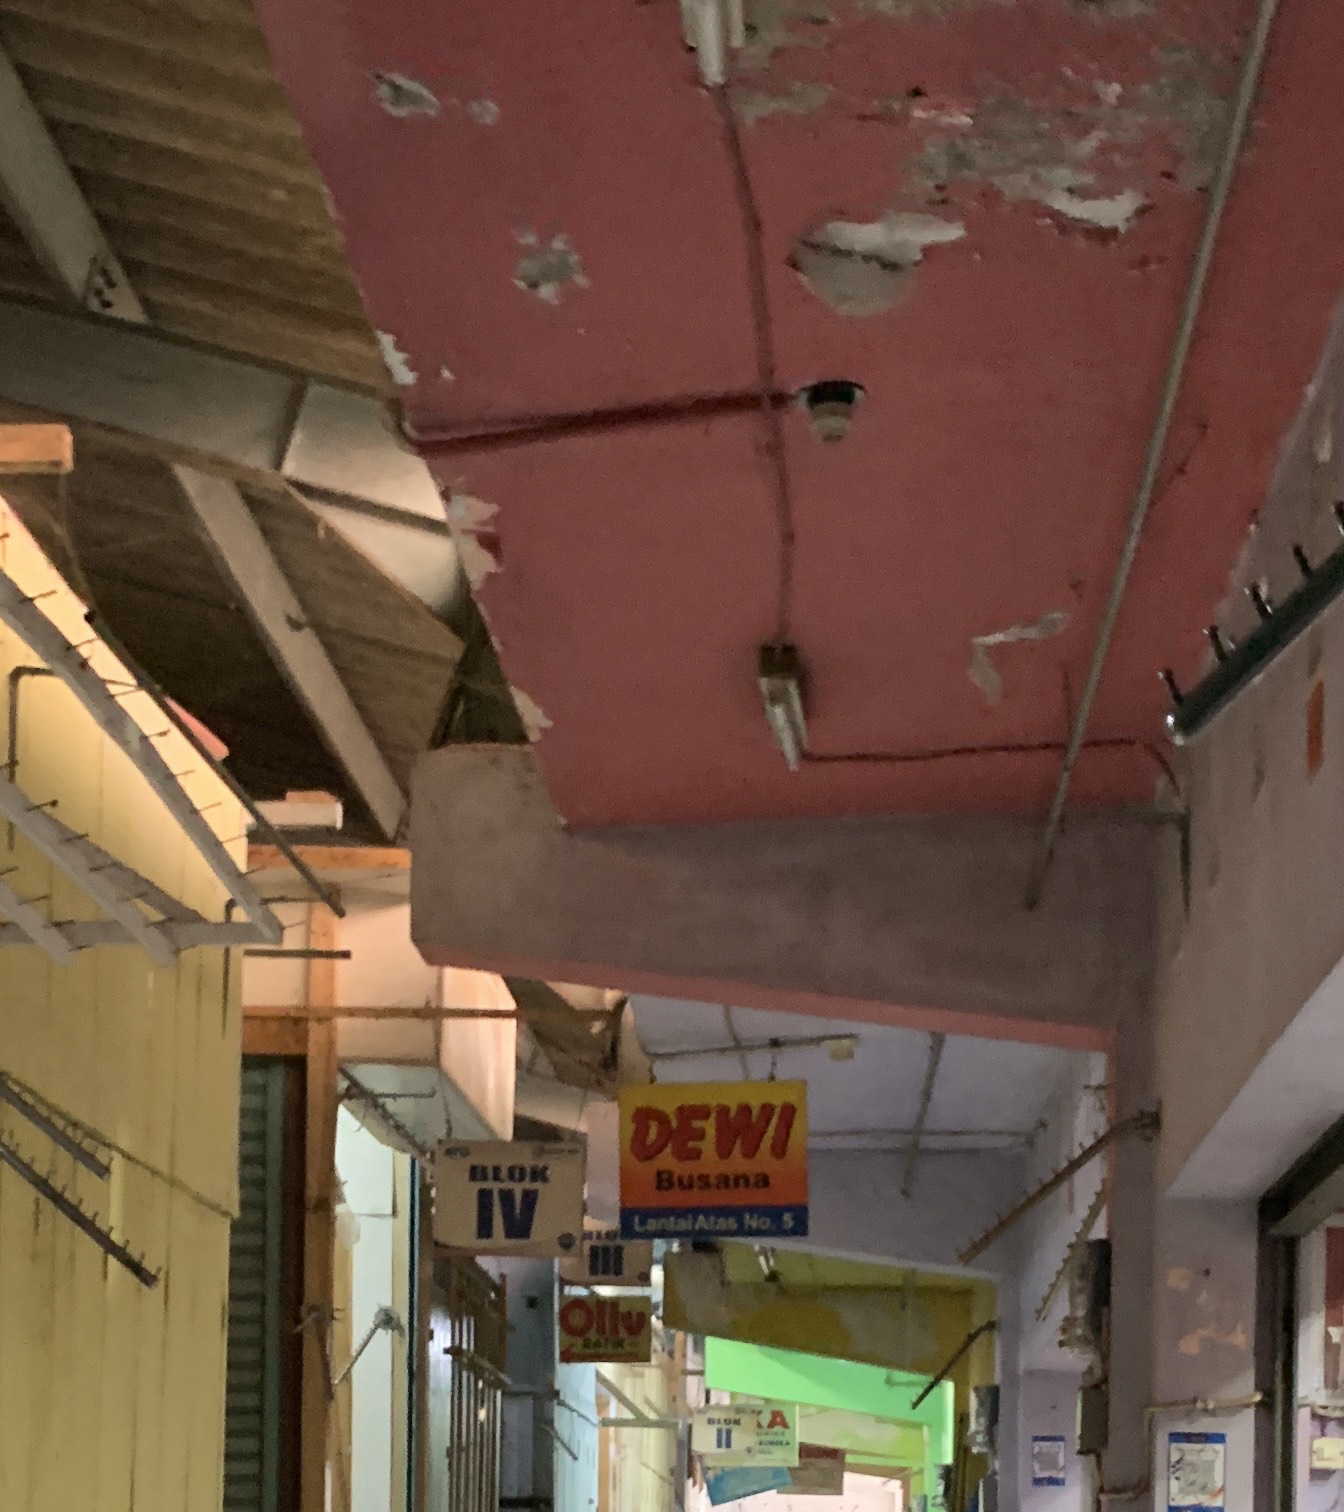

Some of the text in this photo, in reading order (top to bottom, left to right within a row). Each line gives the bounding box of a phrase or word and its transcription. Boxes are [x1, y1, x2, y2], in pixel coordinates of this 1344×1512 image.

[629, 1102, 797, 1162] DEWI
[468, 1163, 550, 1184] BLOK
[655, 1169, 771, 1191] Busana
[476, 1187, 539, 1240] IV
[589, 1244, 624, 1277] III
[716, 1427, 732, 1449] II
